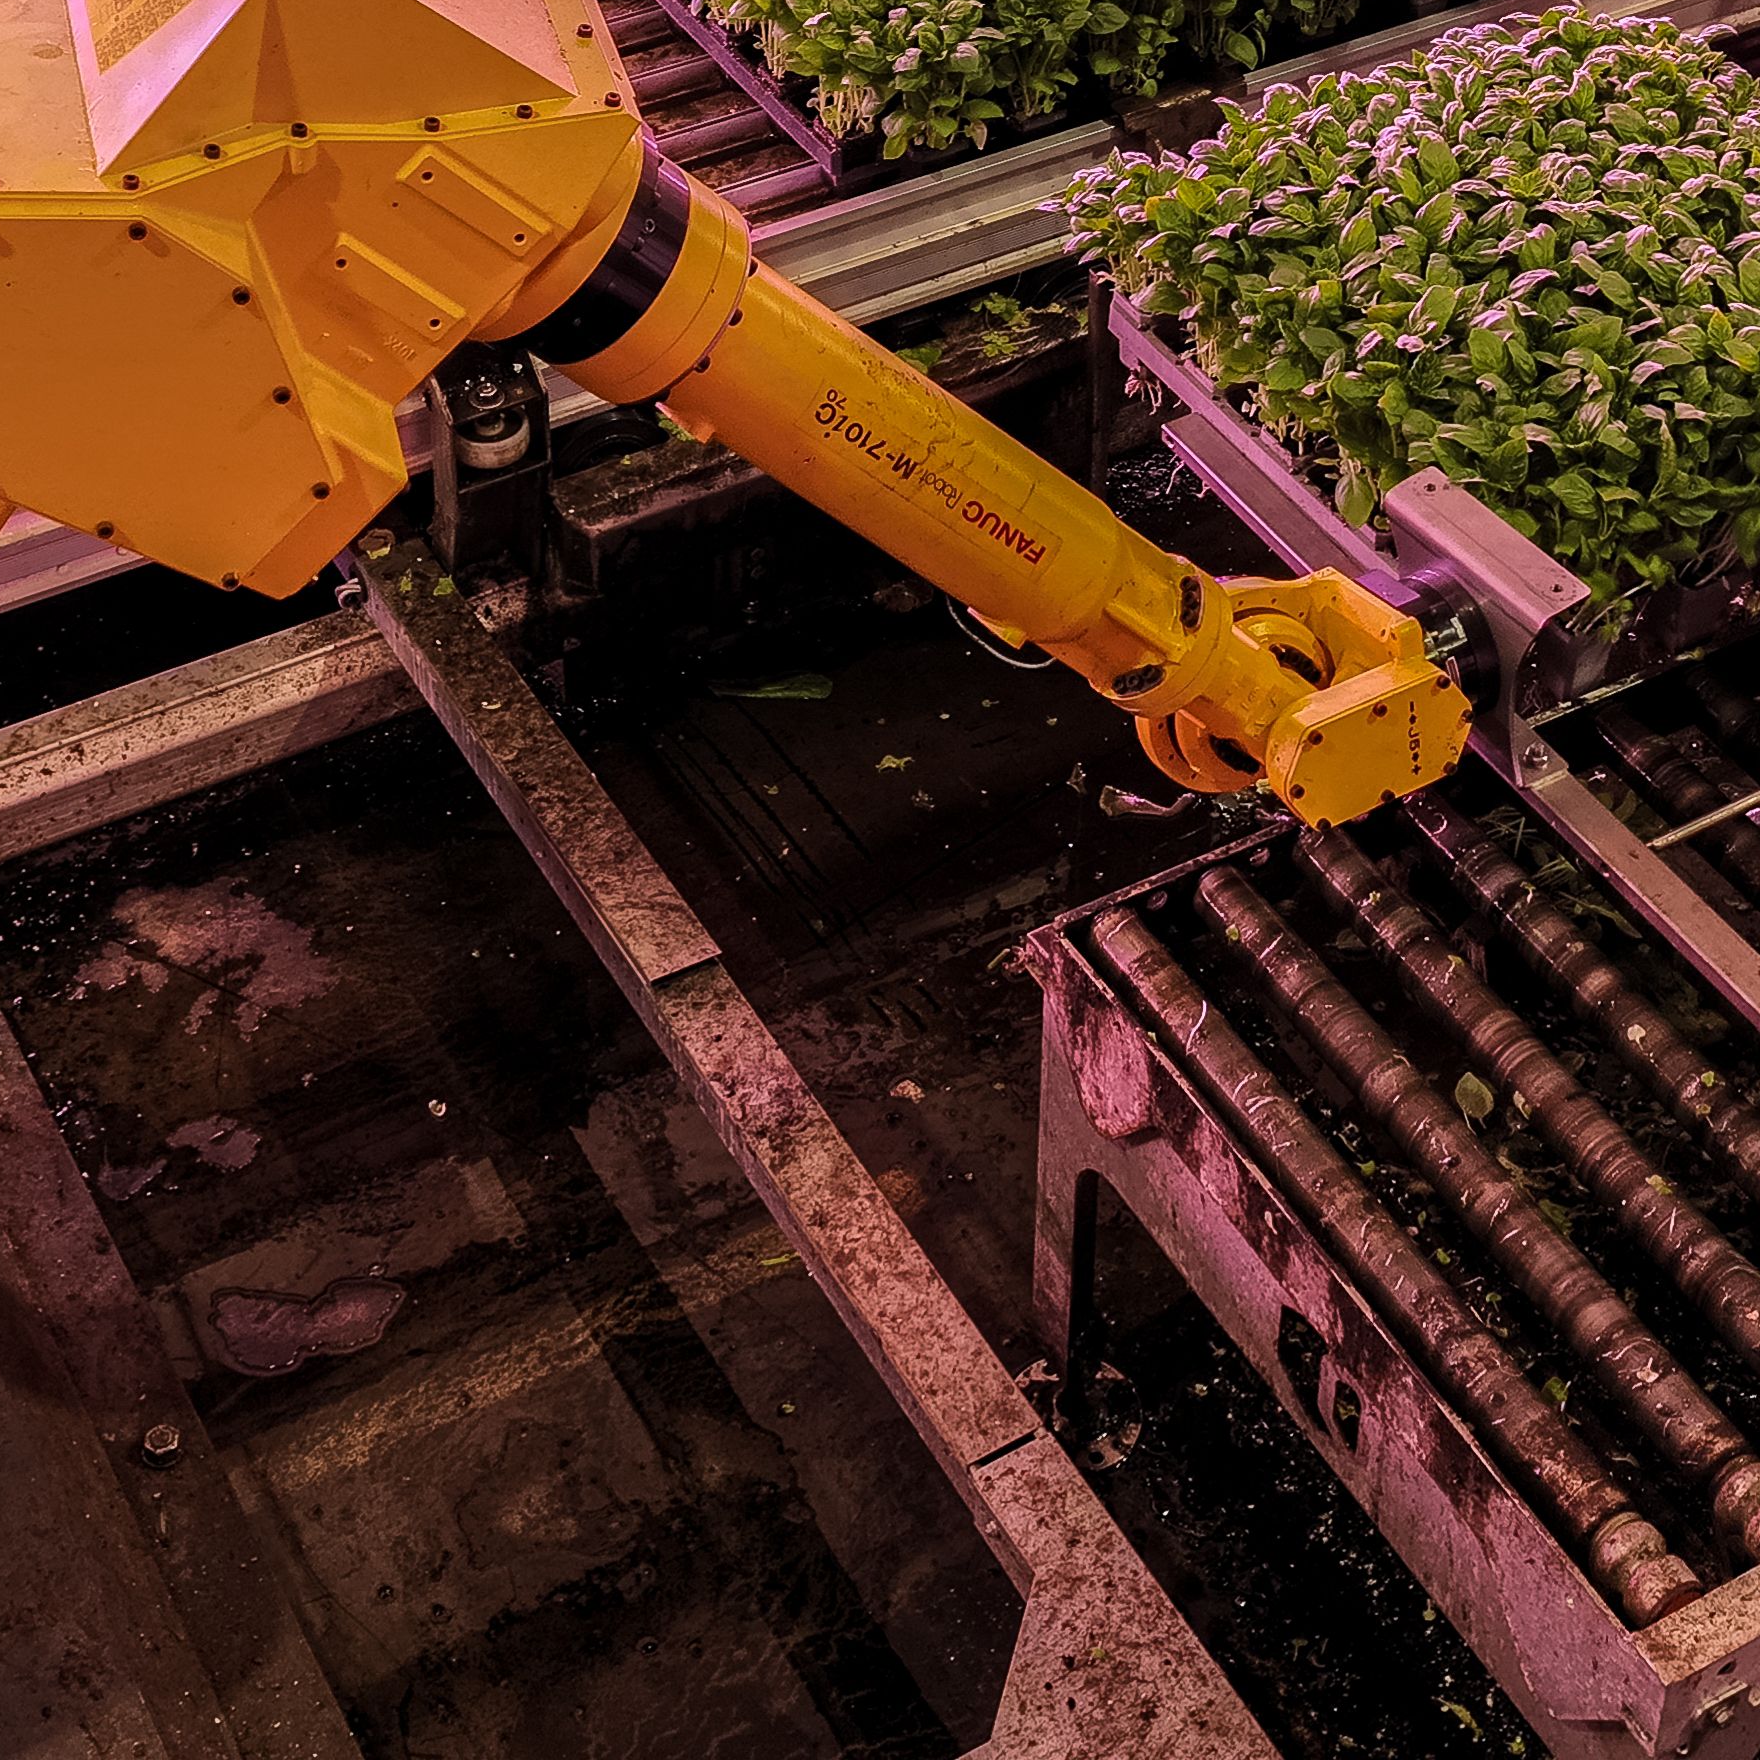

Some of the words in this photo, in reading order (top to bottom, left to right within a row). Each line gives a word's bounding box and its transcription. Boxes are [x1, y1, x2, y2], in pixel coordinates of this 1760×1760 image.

[826, 388, 848, 410] 70
[921, 470, 964, 509] Robot
[961, 500, 1046, 565] FANUC
